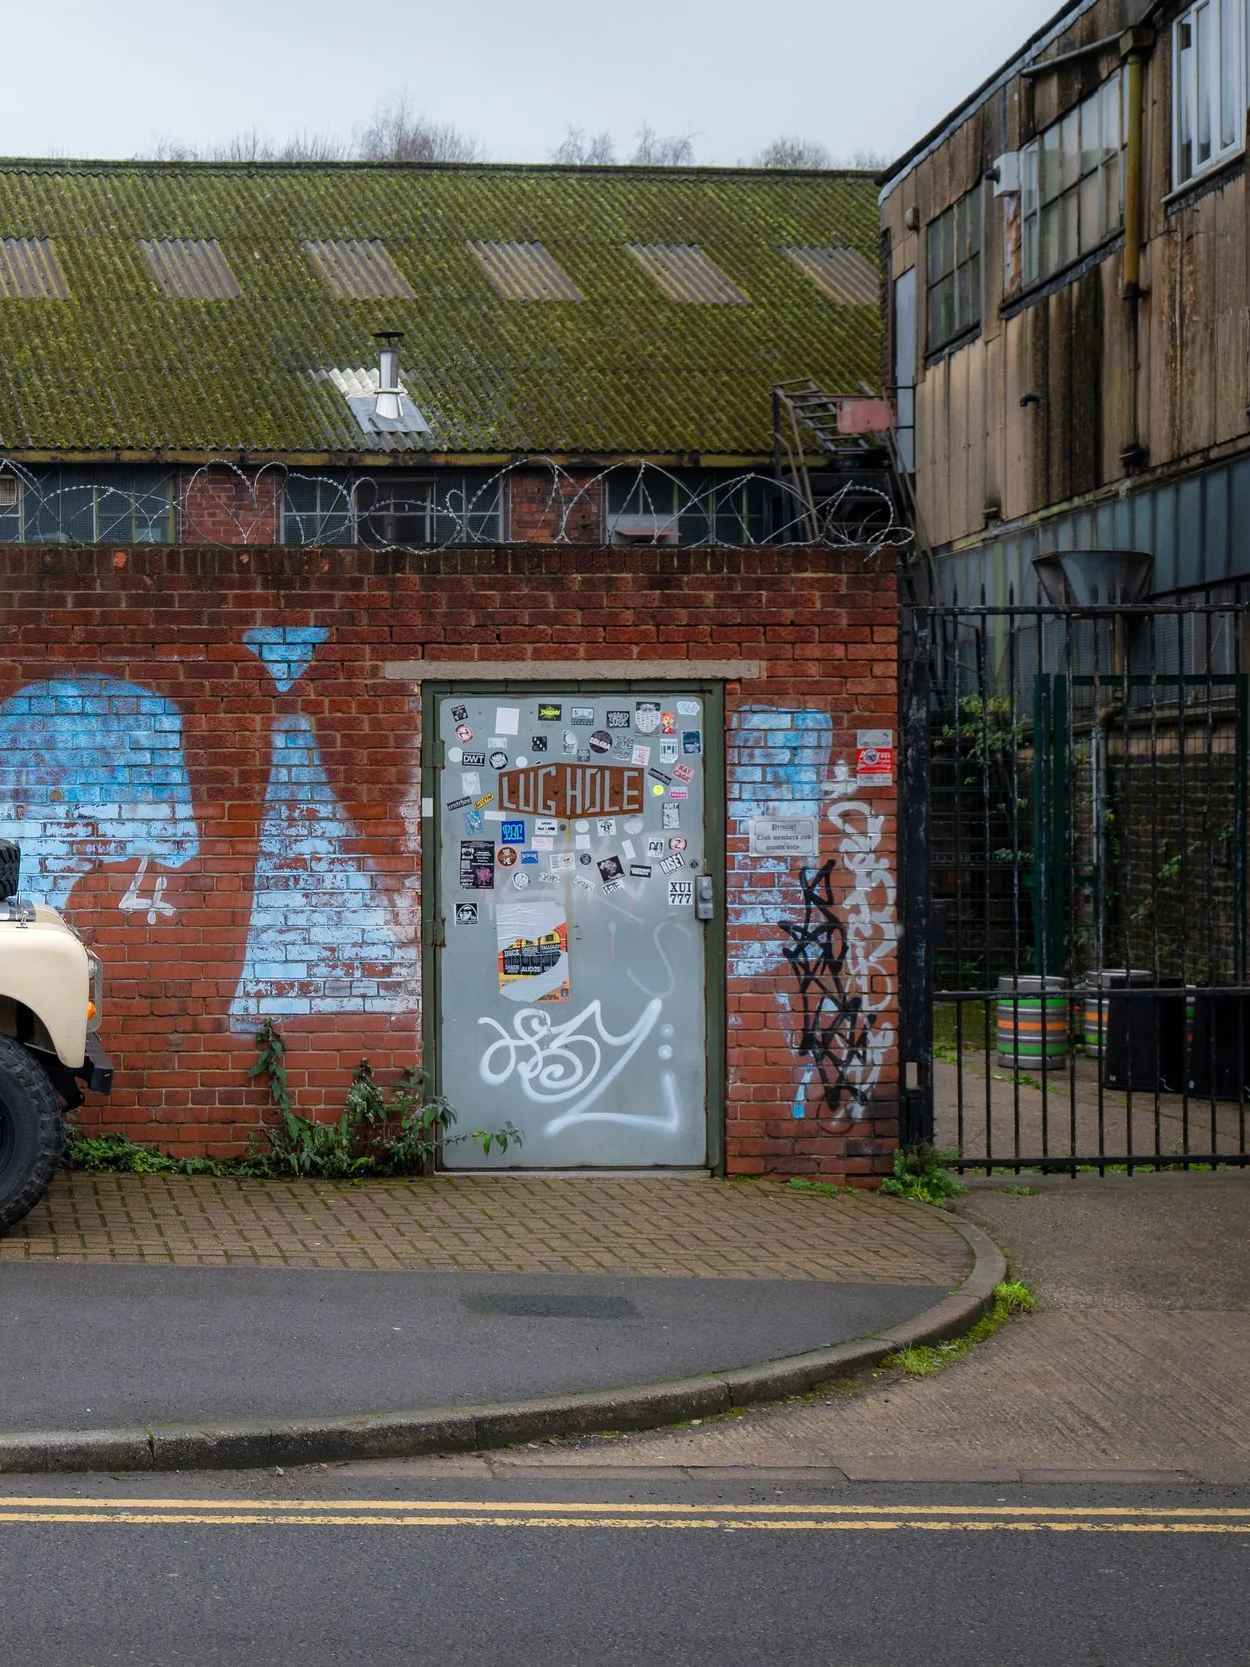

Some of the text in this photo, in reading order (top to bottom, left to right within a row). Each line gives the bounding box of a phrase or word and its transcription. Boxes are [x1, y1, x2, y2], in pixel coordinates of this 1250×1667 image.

[463, 755, 485, 763] DWT
[678, 765, 692, 775] RAT
[673, 770, 691, 783] CAGE
[502, 765, 640, 816] LUG HOLE
[756, 833, 771, 841] Club
[773, 833, 799, 841] members
[119, 857, 176, 925] 4
[669, 882, 692, 892] XUI
[669, 893, 692, 904] 777
